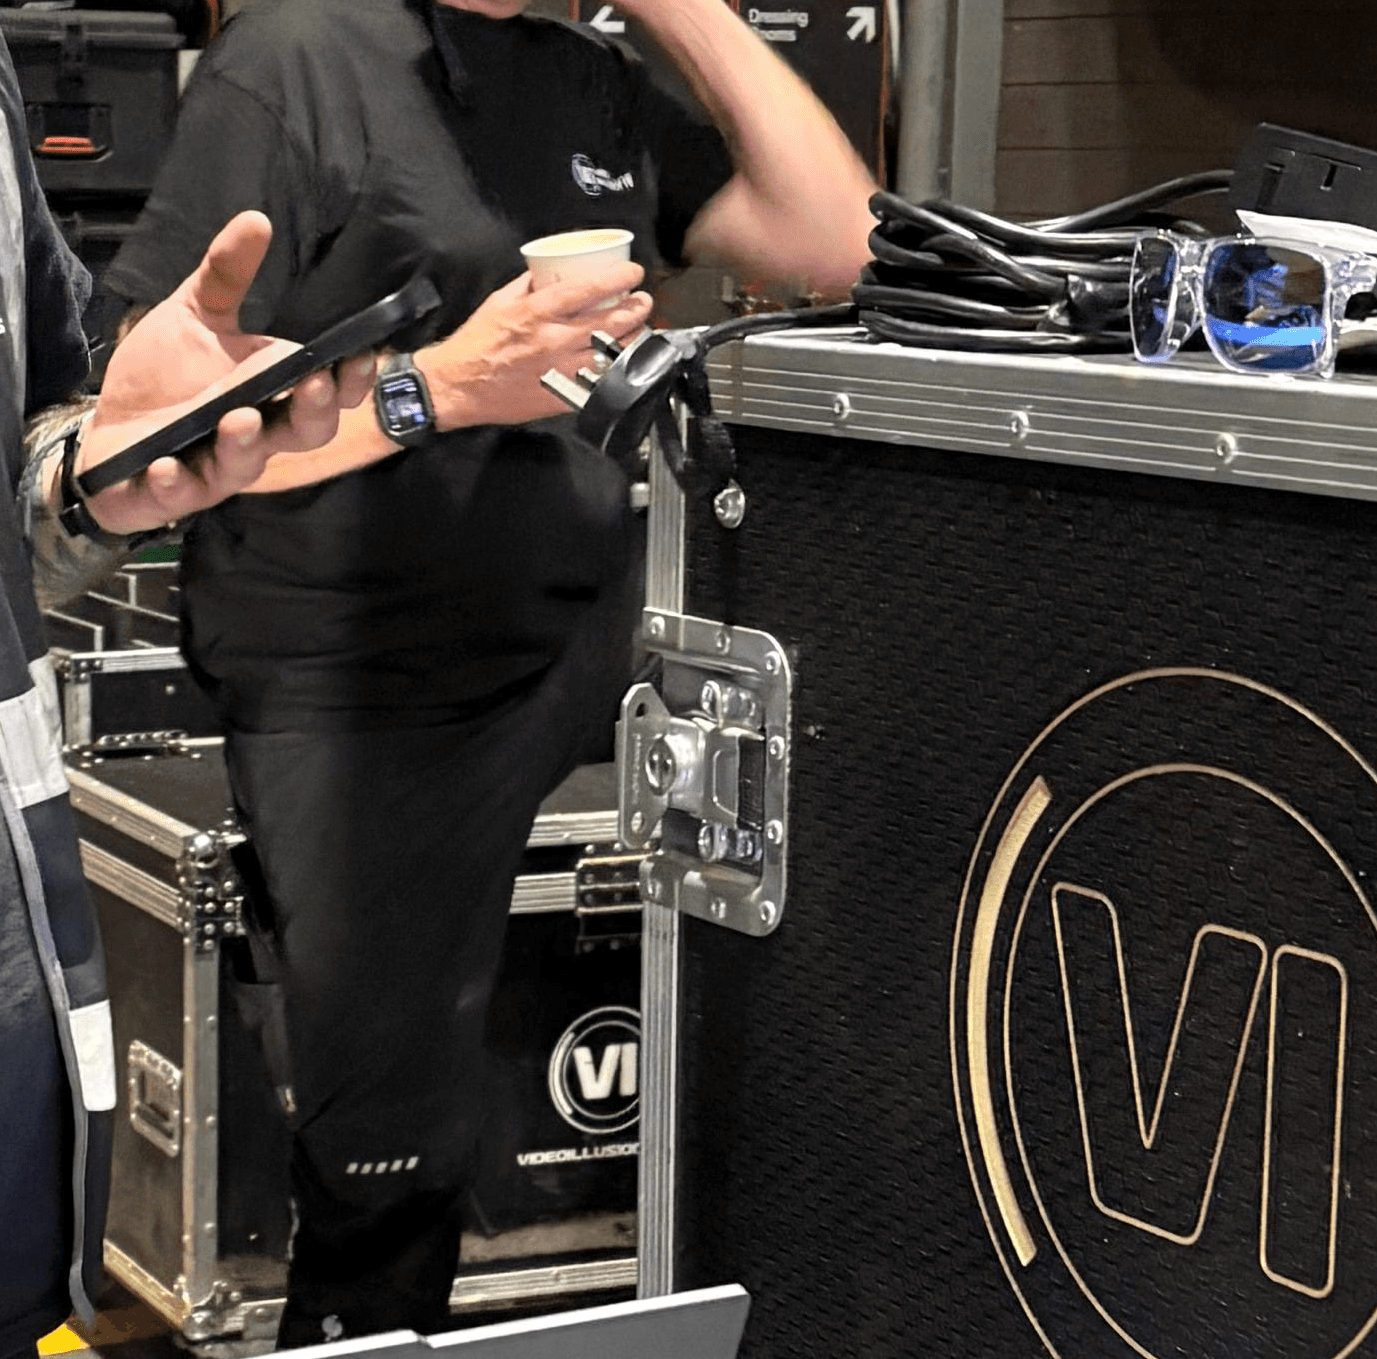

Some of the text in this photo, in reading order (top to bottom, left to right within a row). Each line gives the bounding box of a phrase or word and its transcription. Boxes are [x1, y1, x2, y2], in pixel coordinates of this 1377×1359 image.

[573, 1042, 638, 1100] VI
[1051, 881, 1347, 1299] VI
[516, 1142, 641, 1167] VIDEOILLUSIO
